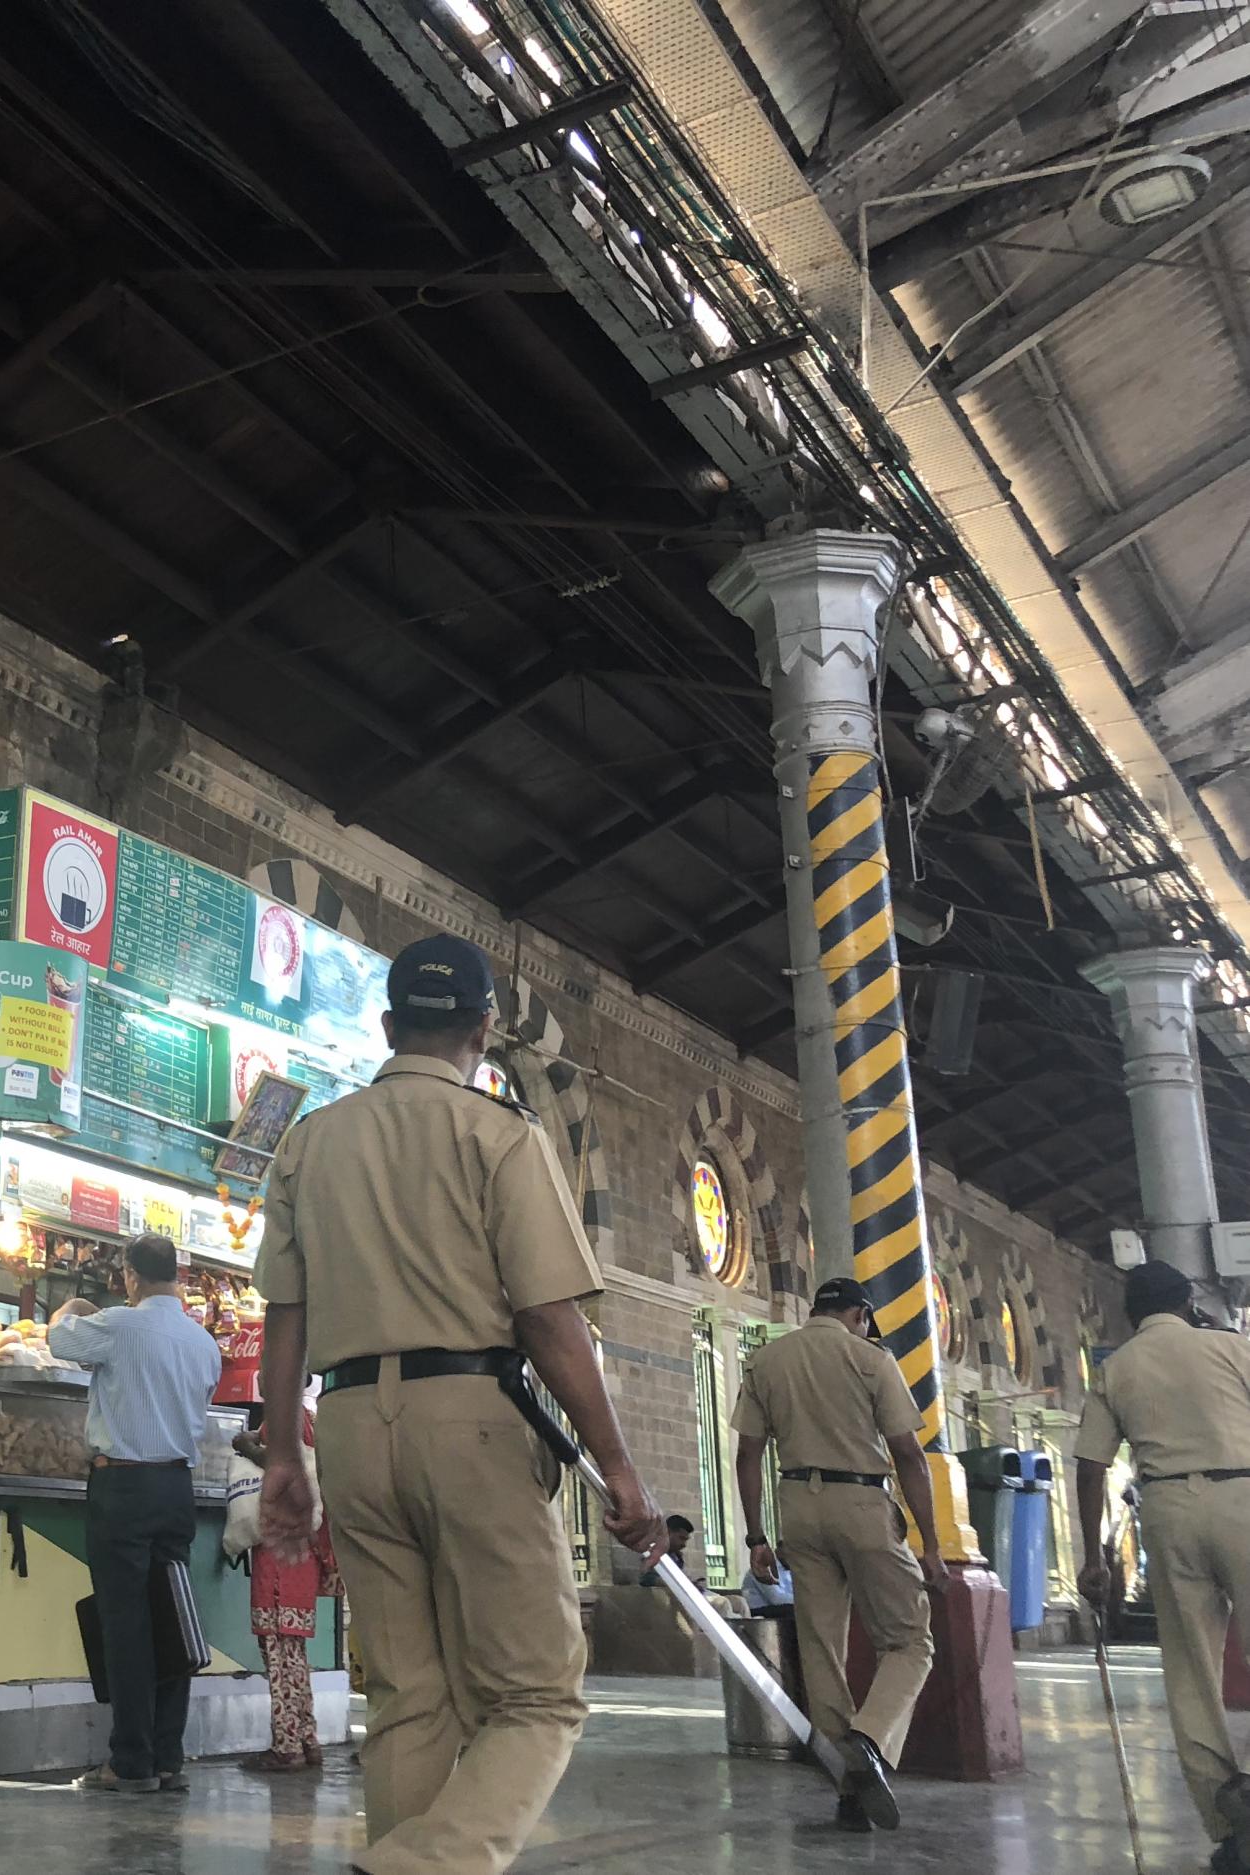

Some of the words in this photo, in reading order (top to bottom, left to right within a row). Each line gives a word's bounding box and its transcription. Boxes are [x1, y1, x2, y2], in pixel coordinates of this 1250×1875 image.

[53, 825, 75, 839] RAIL
[77, 828, 103, 858] AHAR
[50, 926, 65, 945] रेल
[65, 932, 92, 956] आहार
[25, 1006, 46, 1017] FOOD
[48, 1012, 63, 1022] FREE
[10, 1016, 46, 1029] WITHOUT
[48, 1023, 61, 1034] BILL
[8, 1027, 33, 1038] DON'T
[36, 1033, 49, 1041] PAY
[16, 1041, 33, 1049] NOT
[34, 1045, 58, 1057] ISSUED
